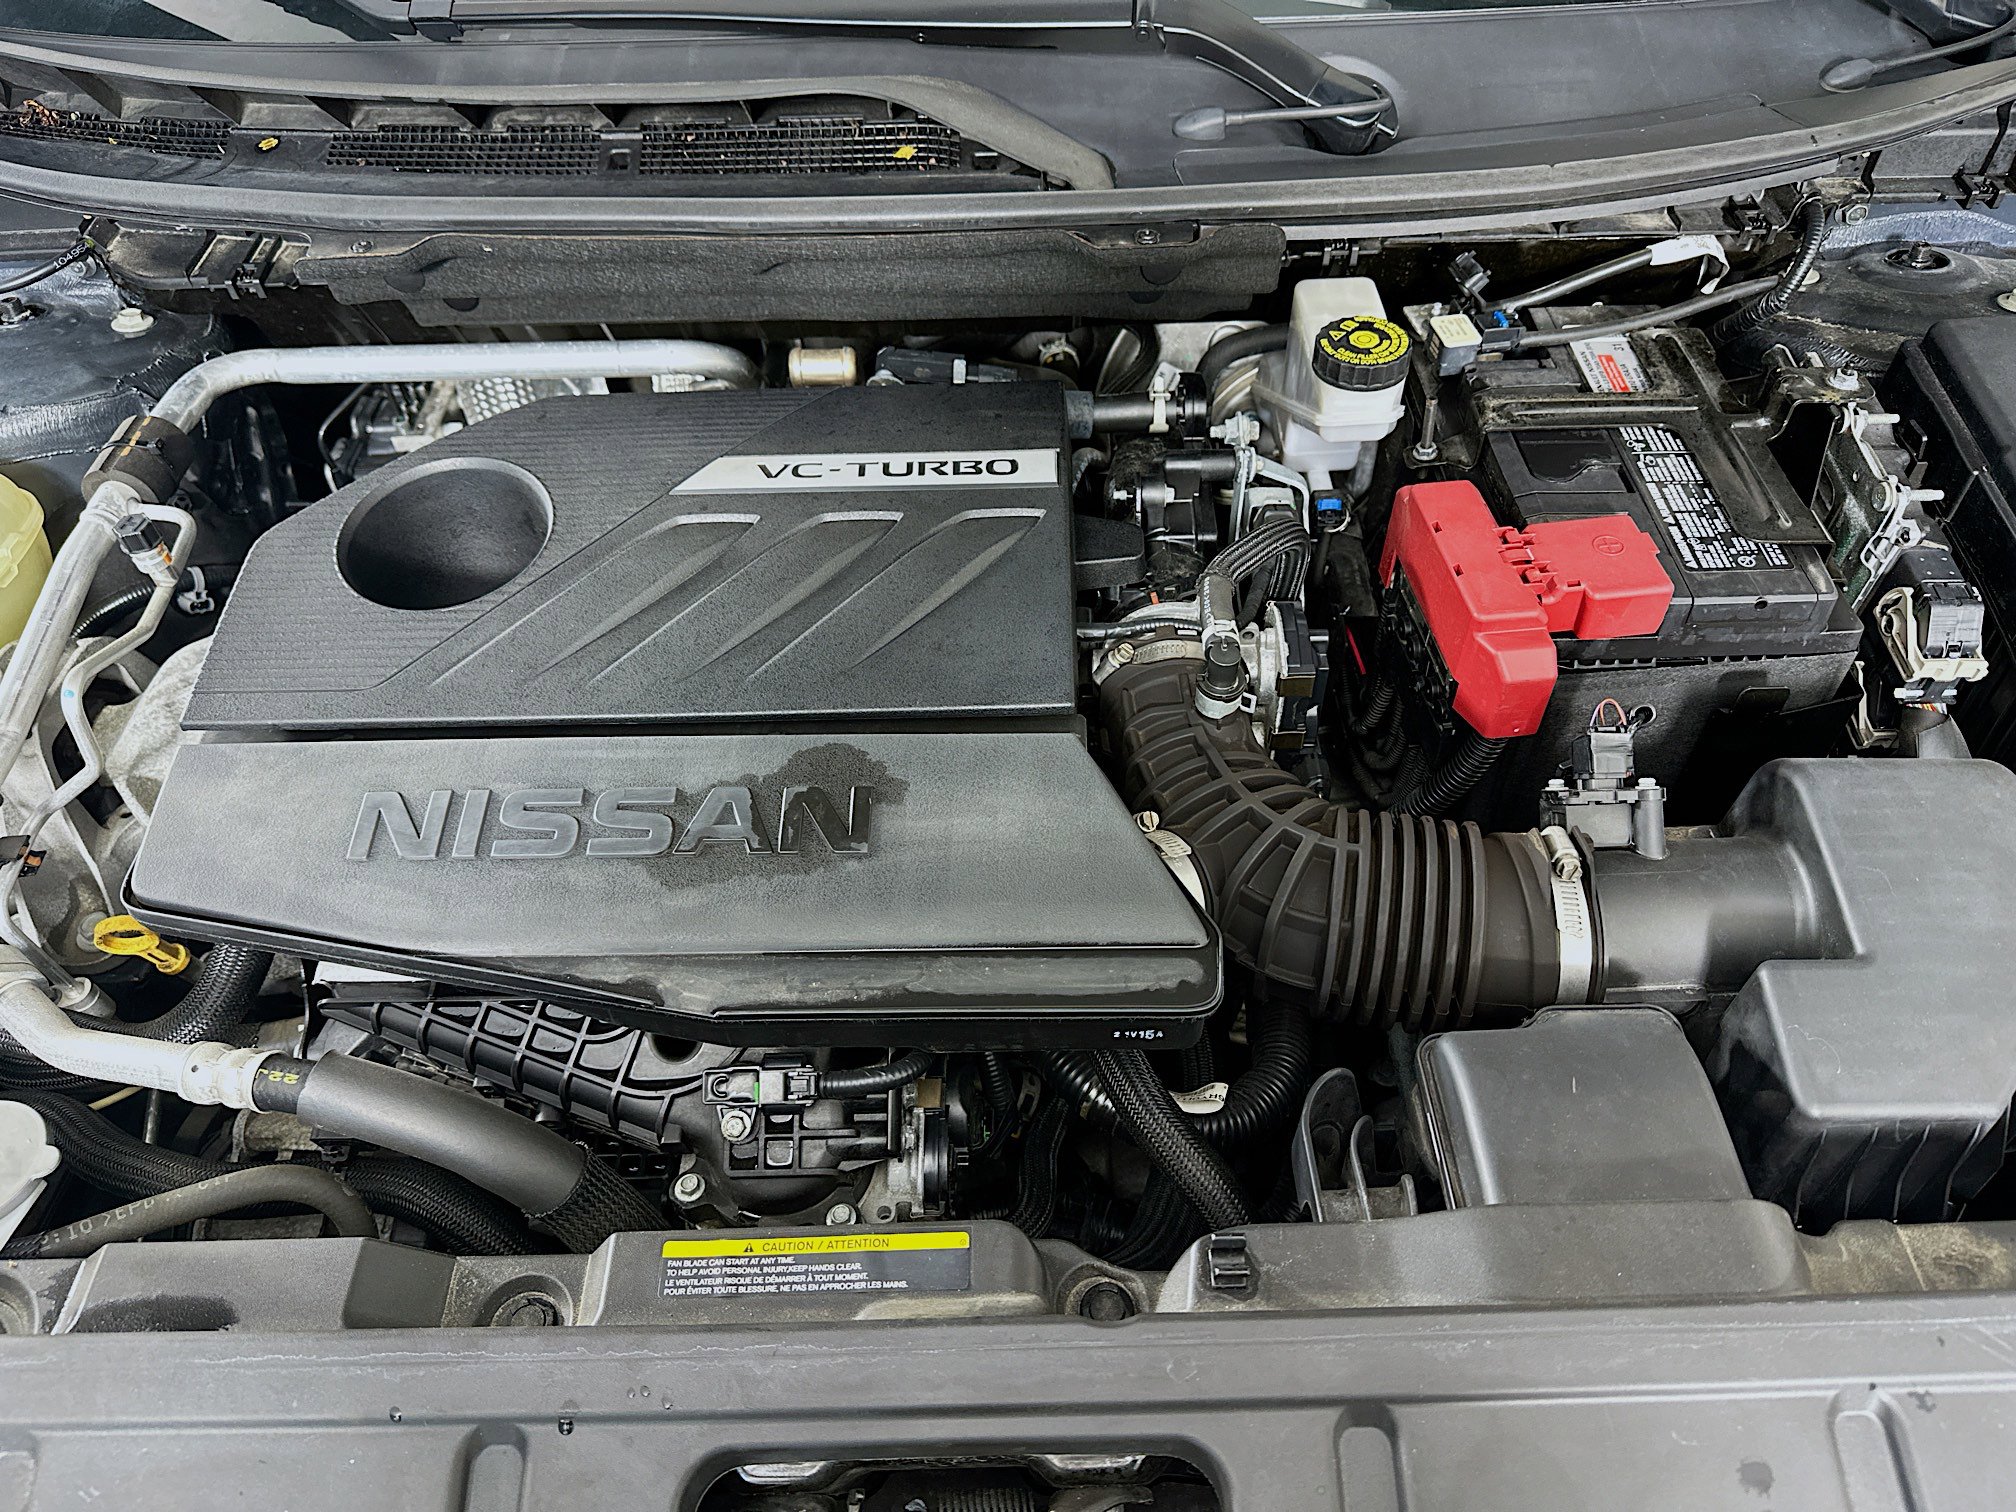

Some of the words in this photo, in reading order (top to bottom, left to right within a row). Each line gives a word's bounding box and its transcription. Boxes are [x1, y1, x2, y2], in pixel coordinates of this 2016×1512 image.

[53, 241, 92, 269] 104954
[756, 458, 1020, 479] VC-TURBO
[346, 786, 873, 861] NISSAN
[762, 1240, 814, 1252] CAUTION
[818, 1240, 824, 1250] /
[826, 1238, 890, 1250] ATTENTION
[666, 1269, 678, 1277] TO
[678, 1268, 698, 1276] HELP
[698, 1267, 722, 1276] AVOID
[722, 1266, 762, 1275] PERSONAL
[808, 1263, 836, 1272] HANDS
[836, 1262, 863, 1271] CLEAR.
[667, 1259, 683, 1268] FAN
[683, 1259, 708, 1267] BLADE
[708, 1258, 725, 1267] CAN
[725, 1257, 750, 1266] START
[750, 1257, 760, 1265] AT
[760, 1256, 776, 1265] ANY
[777, 1256, 796, 1264] TIME.
[664, 1279, 675, 1287] LE
[675, 1277, 723, 1287] VENTILATEUR
[723, 1276, 753, 1285] RISQUE
[753, 1276, 764, 1284] DE
[764, 1273, 807, 1284] DÉMARRER
[807, 1273, 813, 1282] À
[813, 1273, 834, 1282] TOUT
[834, 1272, 869, 1281] MOMENT.
[663, 1288, 686, 1296] POUR
[686, 1285, 712, 1296] ÉVITER
[712, 1286, 738, 1295] TOUTE
[738, 1284, 779, 1294] BLESSURE,
[780, 1284, 791, 1292] NE
[792, 1283, 807, 1292] PAS
[808, 1283, 819, 1291] EN
[819, 1281, 867, 1291] APPROCHER
[867, 1281, 882, 1289] LES
[882, 1280, 909, 1289] MAINS.
